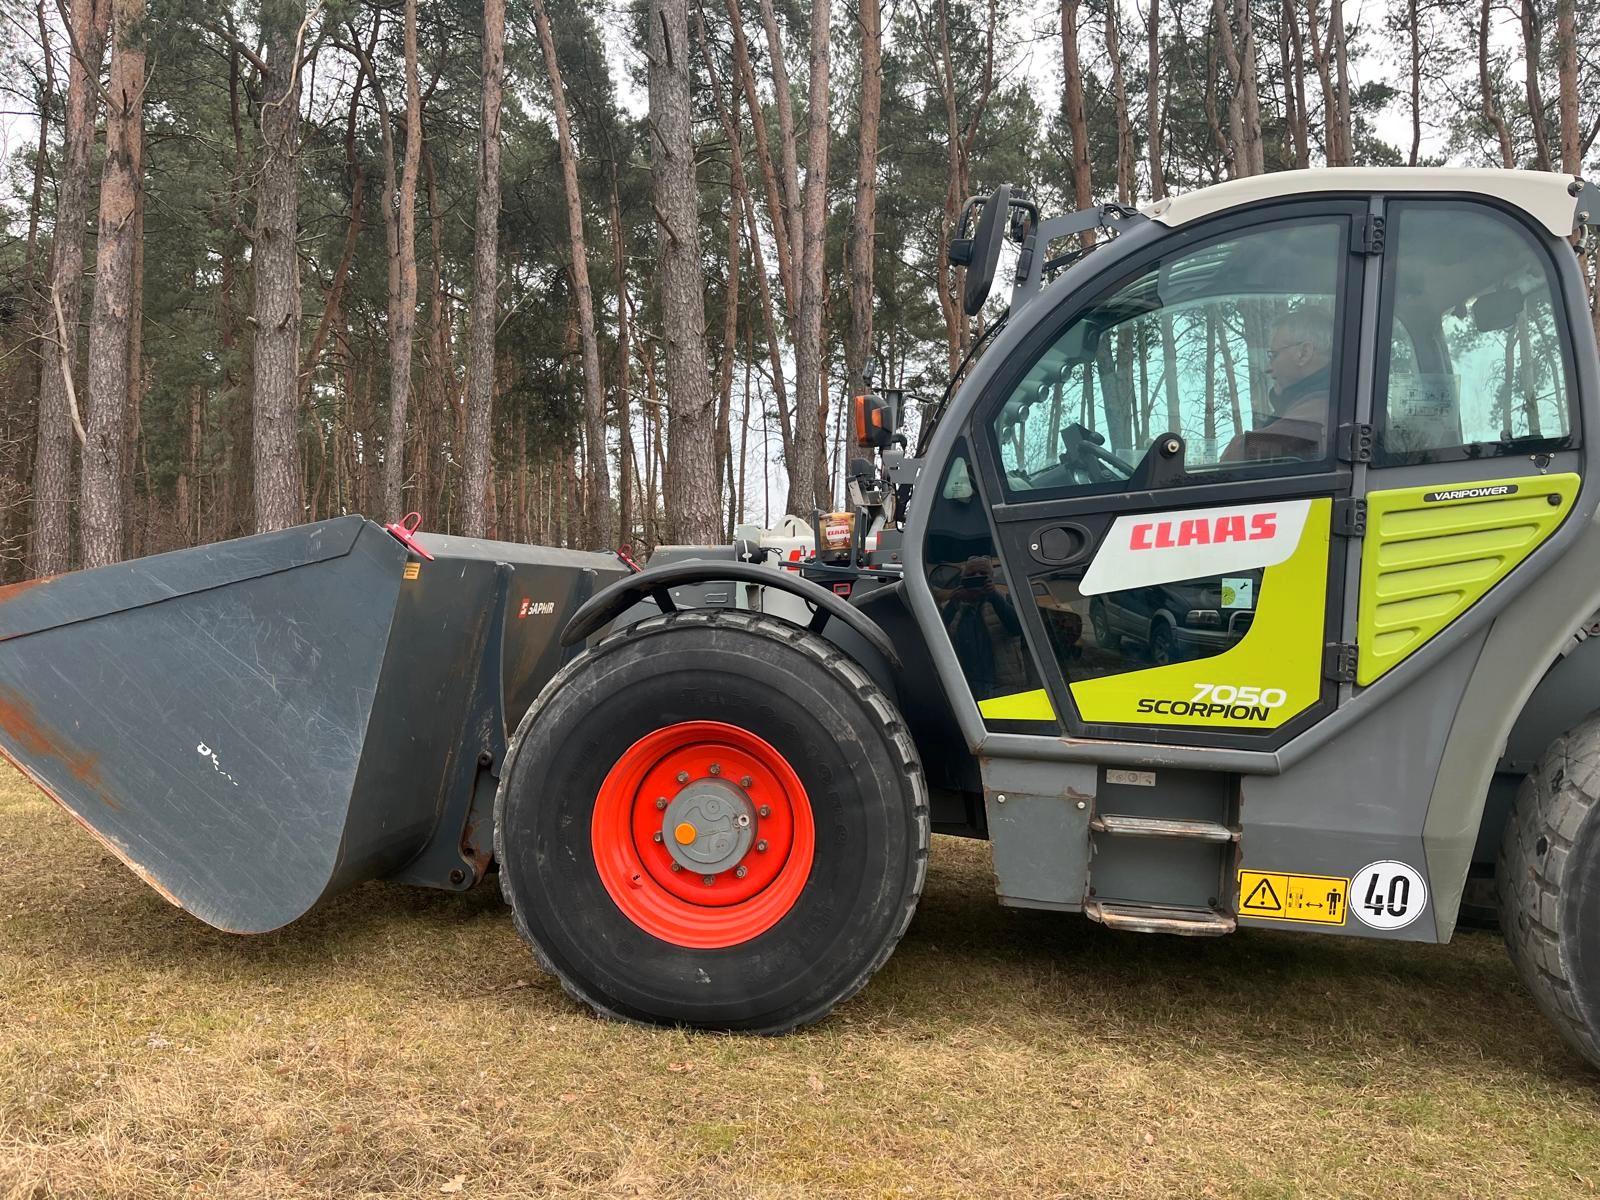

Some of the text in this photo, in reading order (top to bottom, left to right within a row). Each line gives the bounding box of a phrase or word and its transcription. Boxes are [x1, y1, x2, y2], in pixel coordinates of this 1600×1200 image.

[1434, 486, 1508, 501] VARIPOWER
[1129, 512, 1277, 551] CLAAS
[1190, 683, 1287, 708] 7050
[1137, 699, 1270, 722] SCORPION
[1363, 873, 1411, 916] 40
